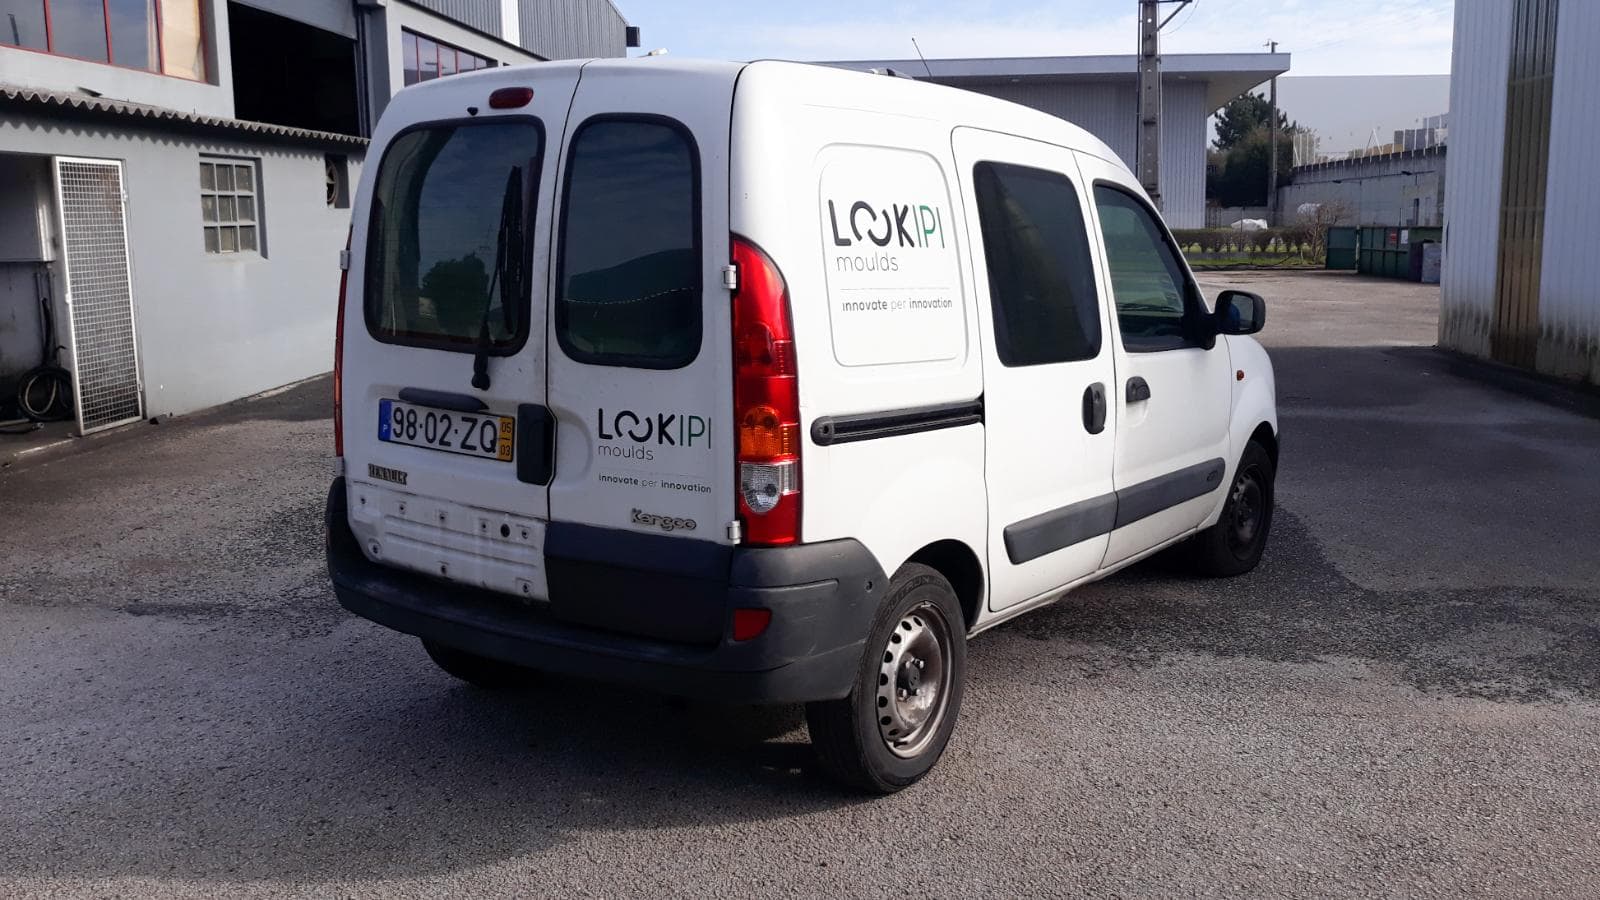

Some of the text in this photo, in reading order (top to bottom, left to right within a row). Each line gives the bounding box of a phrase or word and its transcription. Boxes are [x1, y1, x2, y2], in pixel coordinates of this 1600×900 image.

[836, 251, 899, 272] moulds
[842, 297, 953, 312] innovate per innovation
[501, 421, 512, 434] 05
[598, 445, 654, 461] moulds
[599, 473, 639, 486] innovate
[661, 480, 712, 494] innovation
